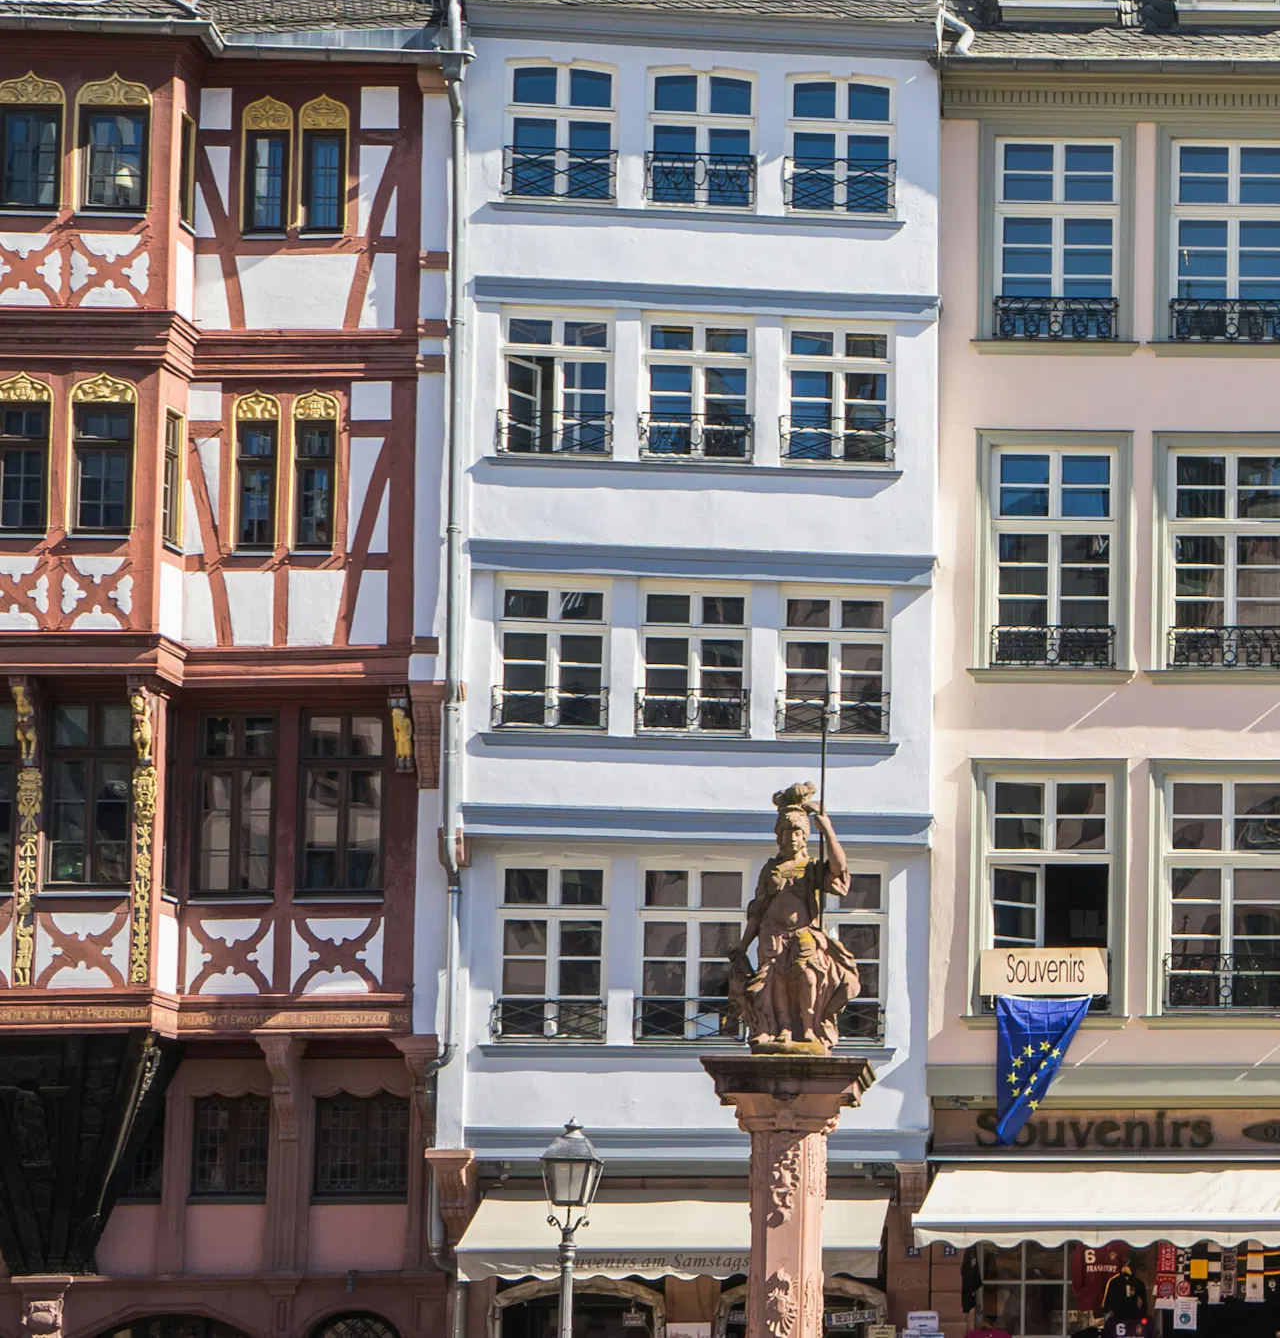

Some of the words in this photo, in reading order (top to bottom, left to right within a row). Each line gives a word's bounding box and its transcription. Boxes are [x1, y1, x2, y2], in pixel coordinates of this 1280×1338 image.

[1006, 953, 1085, 983] Souvenirs
[975, 1111, 1215, 1149] Souvenirs
[553, 1253, 637, 1269] Suvenirs
[641, 1257, 666, 1268] am
[1084, 1249, 1096, 1264] 6
[1115, 1323, 1126, 1336] 6
